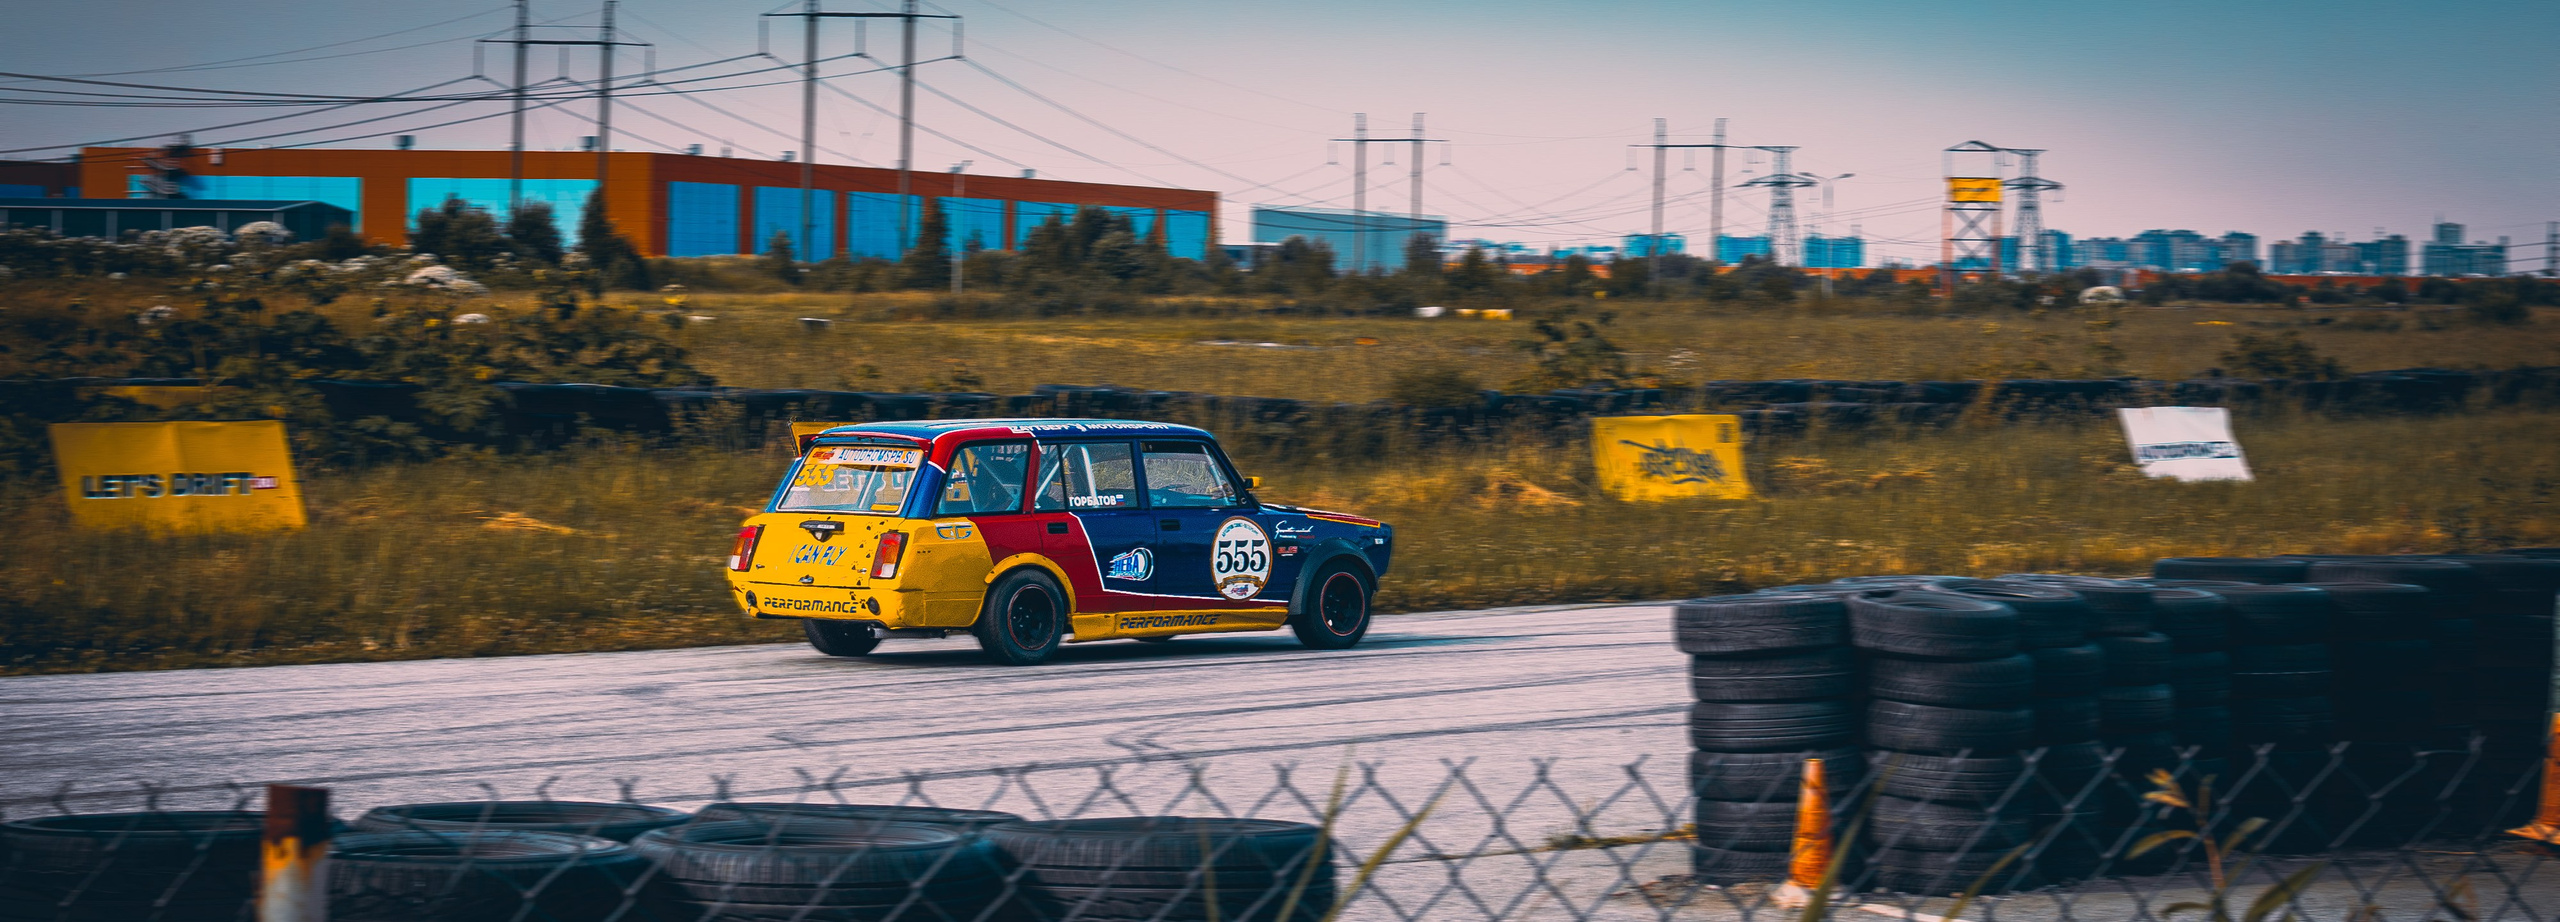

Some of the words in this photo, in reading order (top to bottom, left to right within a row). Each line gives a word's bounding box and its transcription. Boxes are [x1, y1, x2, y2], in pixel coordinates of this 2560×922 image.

[82, 473, 167, 498] LET'S
[169, 472, 253, 496] DRIFT
[794, 464, 839, 486] 555
[1068, 495, 1117, 508] ГОРБАТОВ
[795, 544, 824, 564] CAN
[819, 545, 848, 566] FLY
[1216, 539, 1267, 573] 555
[764, 597, 859, 613] PERFORMANCE
[1120, 614, 1221, 629] PERFORMANCE
